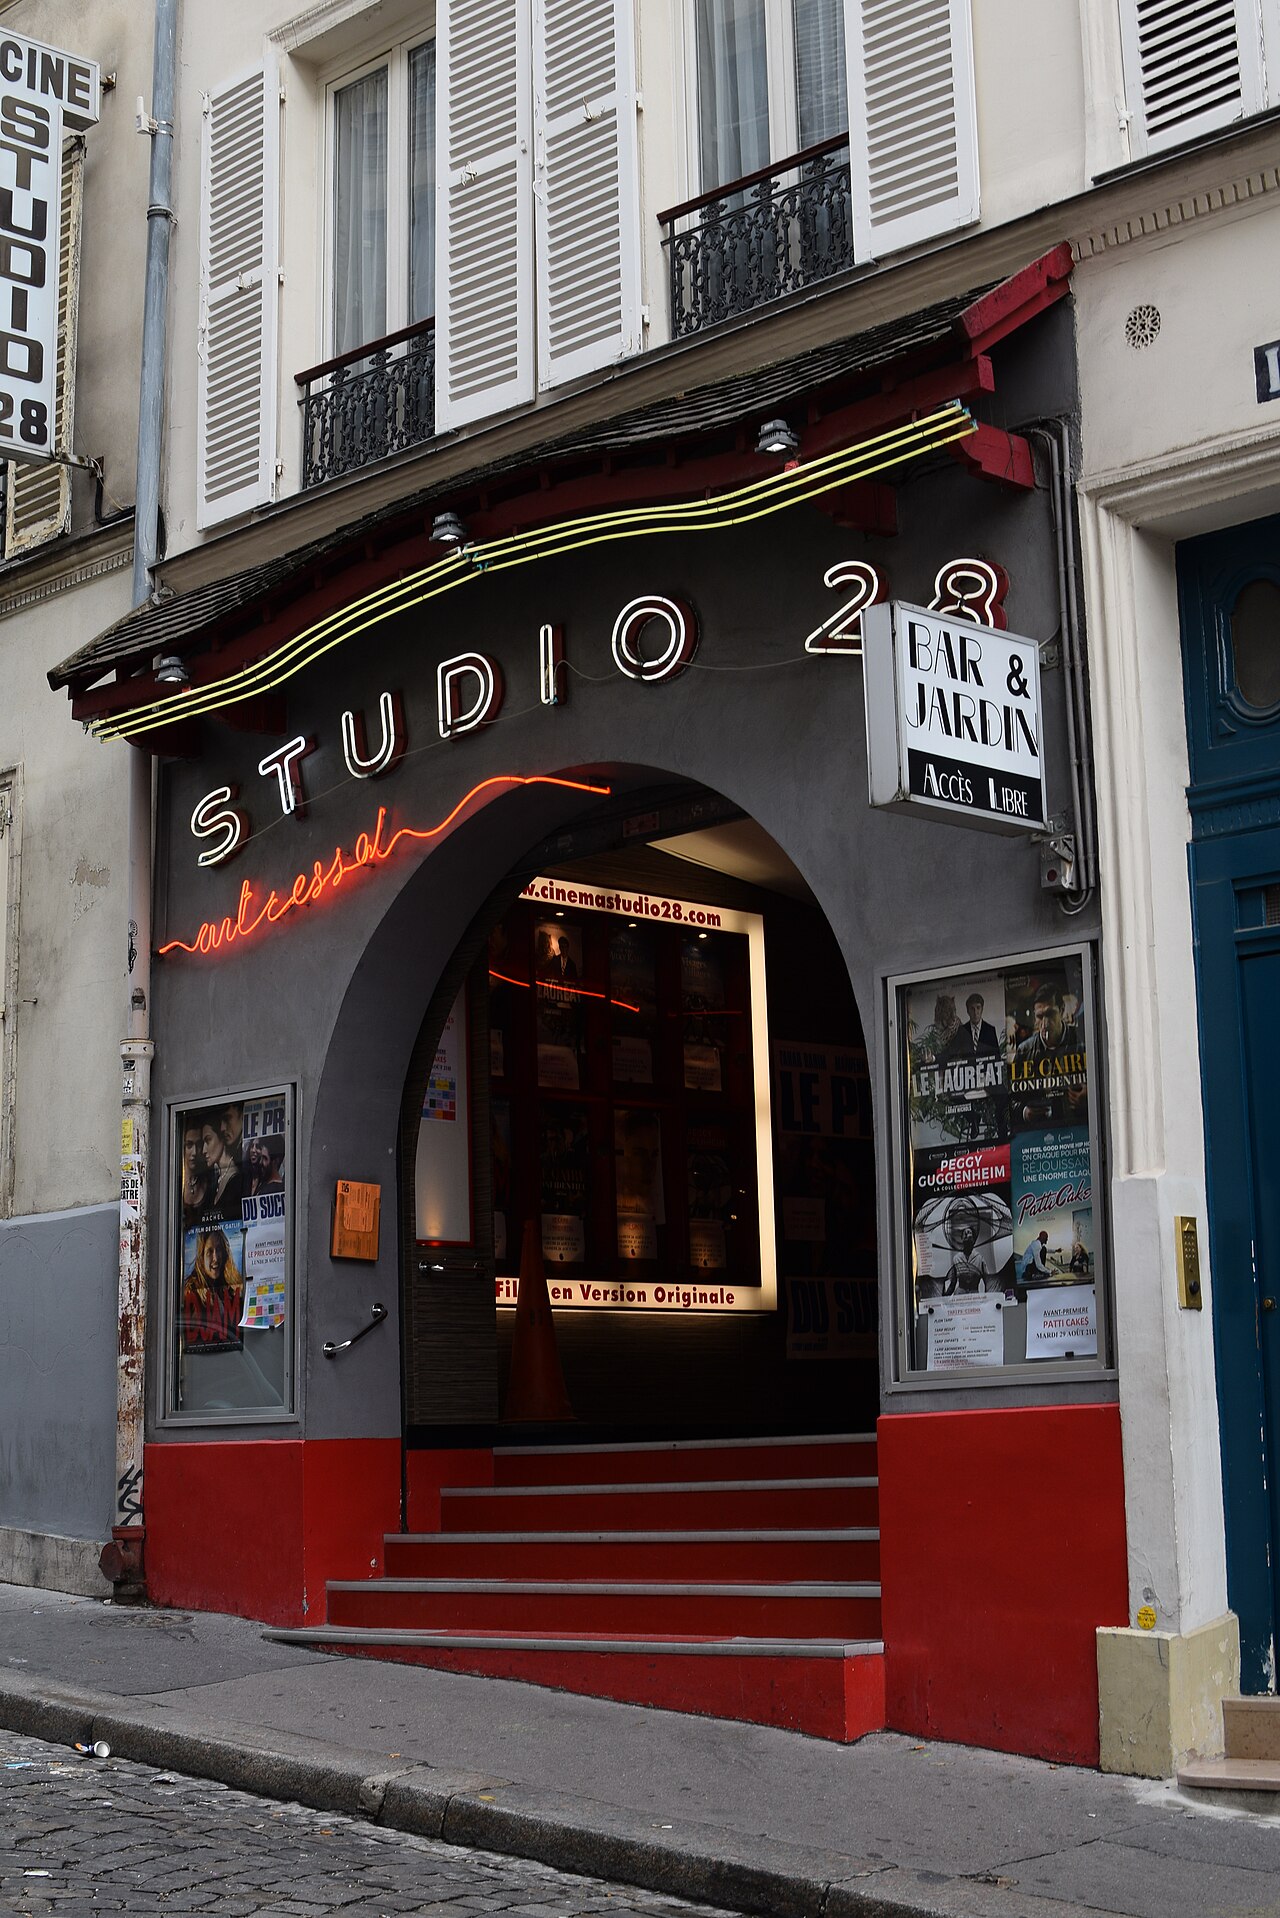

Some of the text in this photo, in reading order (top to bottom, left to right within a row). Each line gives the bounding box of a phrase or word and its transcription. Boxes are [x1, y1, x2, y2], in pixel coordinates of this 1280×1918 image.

[0, 40, 91, 109] CINE
[0, 95, 50, 383] STUDIO
[0, 392, 47, 445] 28
[908, 620, 1031, 700] BAR &
[190, 557, 1005, 868] STUDIO 28
[905, 682, 1039, 757] JARDIN
[912, 1060, 1004, 1098] LE LAURÉAT
[1011, 1060, 1035, 1081] LE
[779, 1071, 820, 1132] LE
[243, 1112, 259, 1139] LE
[1033, 1150, 1060, 1161] CRAQUE
[1060, 1149, 1078, 1157] POUR
[1043, 1144, 1059, 1152] GOOD
[940, 1154, 983, 1172] PEGGY
[918, 1165, 1005, 1188] GUGGENHEIM
[1023, 1174, 1037, 1183] UNE
[1038, 1170, 1068, 1181] ÉNORME
[201, 1213, 224, 1222] RACHEL
[242, 1197, 258, 1222] DU
[1016, 1190, 1057, 1227] Patti
[265, 1248, 273, 1256] DU
[551, 1286, 573, 1300] en
[579, 1283, 647, 1303] Version
[654, 1285, 736, 1308] Originale
[184, 1286, 241, 1344] DJAM
[1043, 1319, 1064, 1329] PATTI
[1036, 1331, 1058, 1340] MARDI
